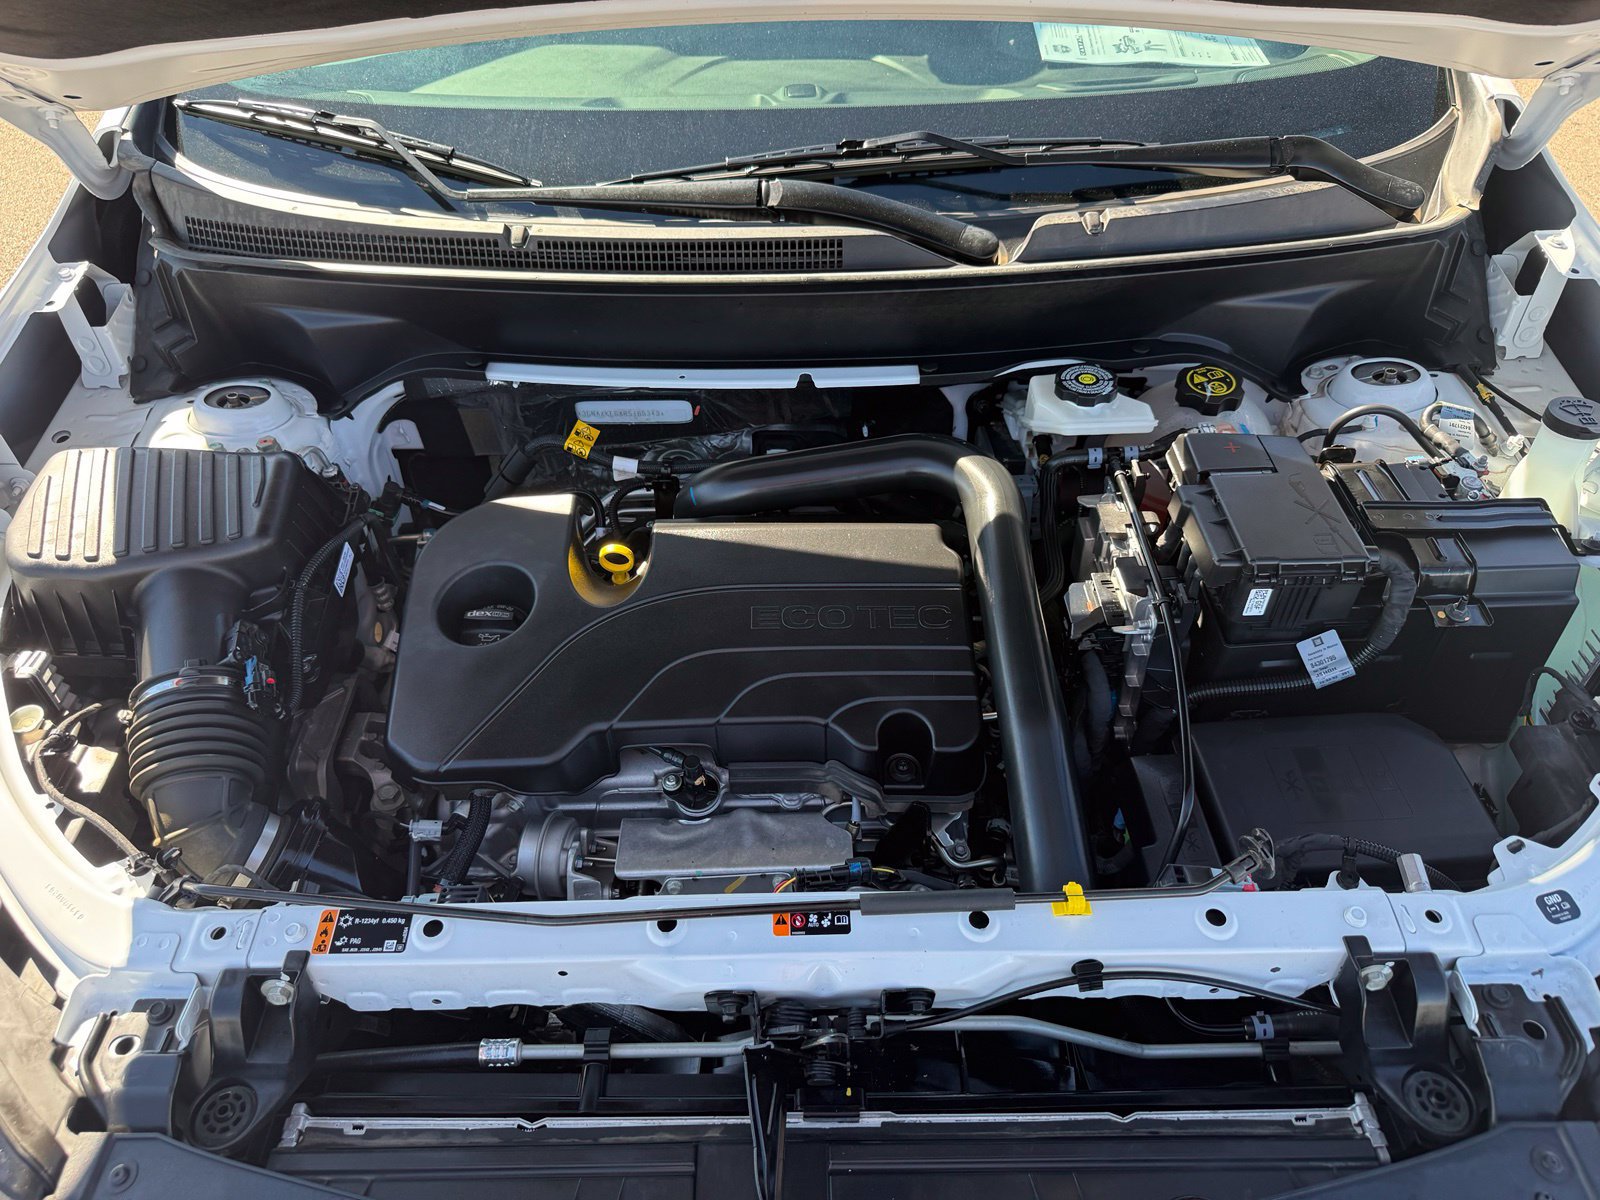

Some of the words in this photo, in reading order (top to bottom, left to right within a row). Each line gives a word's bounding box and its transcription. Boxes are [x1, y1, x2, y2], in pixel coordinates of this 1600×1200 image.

[750, 604, 952, 630] ECOTEC
[1543, 893, 1562, 905] GND
[354, 917, 380, 926] R-1234yf
[397, 917, 406, 925] kg
[349, 937, 362, 945] PAG
